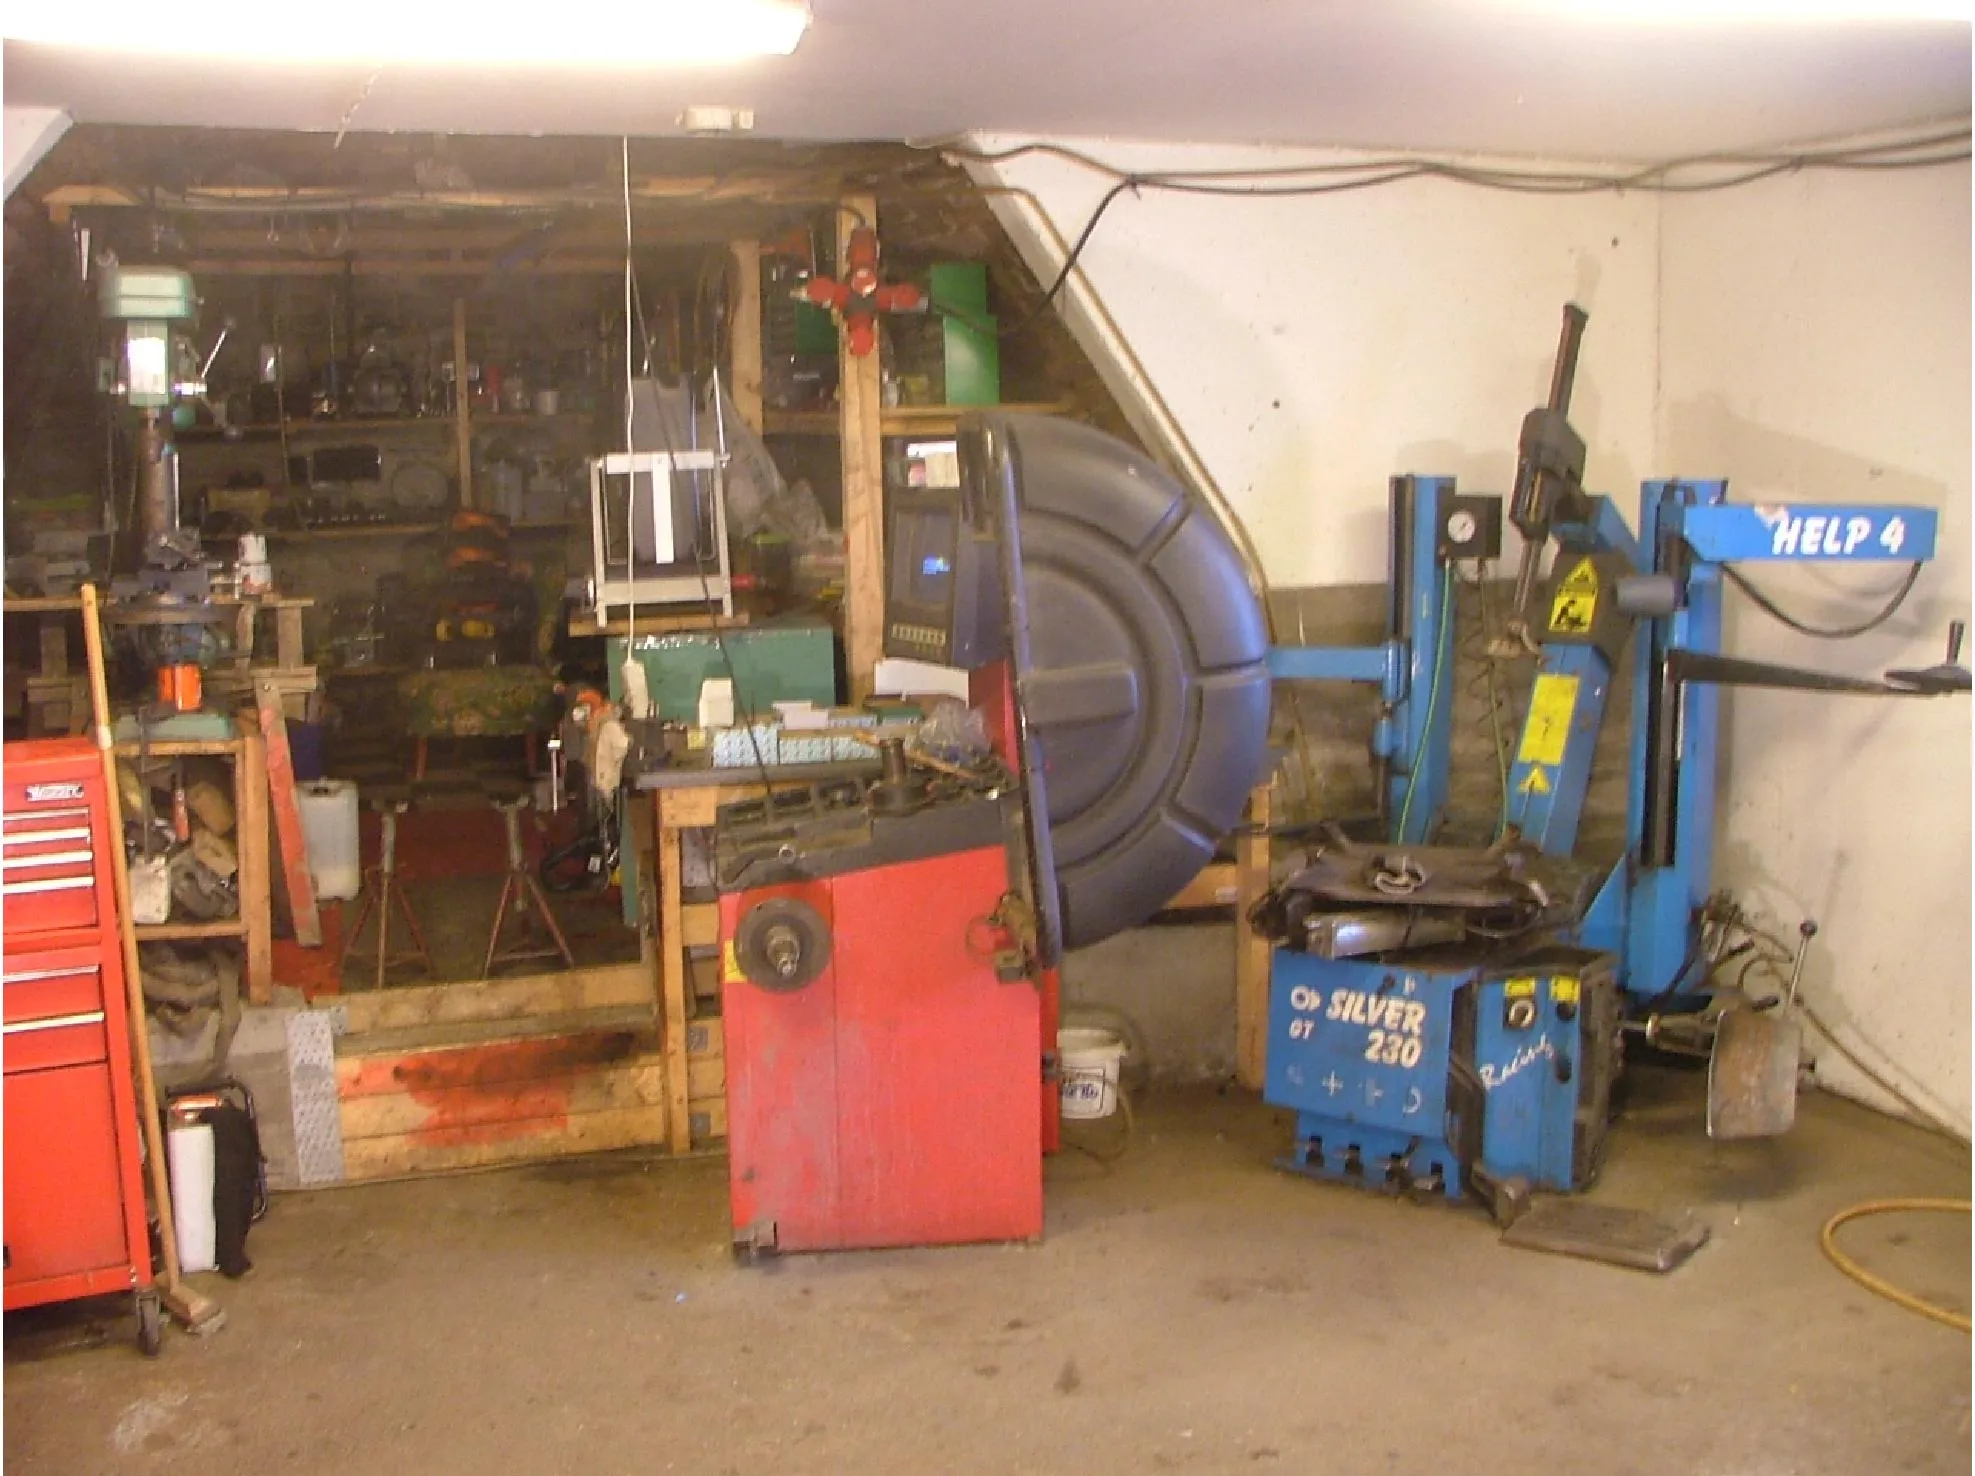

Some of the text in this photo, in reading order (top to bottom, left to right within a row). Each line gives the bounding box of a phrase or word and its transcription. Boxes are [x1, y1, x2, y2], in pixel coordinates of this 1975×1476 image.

[1772, 515, 1905, 555] HELP 4
[1326, 987, 1426, 1036] SILVER
[1365, 1029, 1422, 1068] 230
